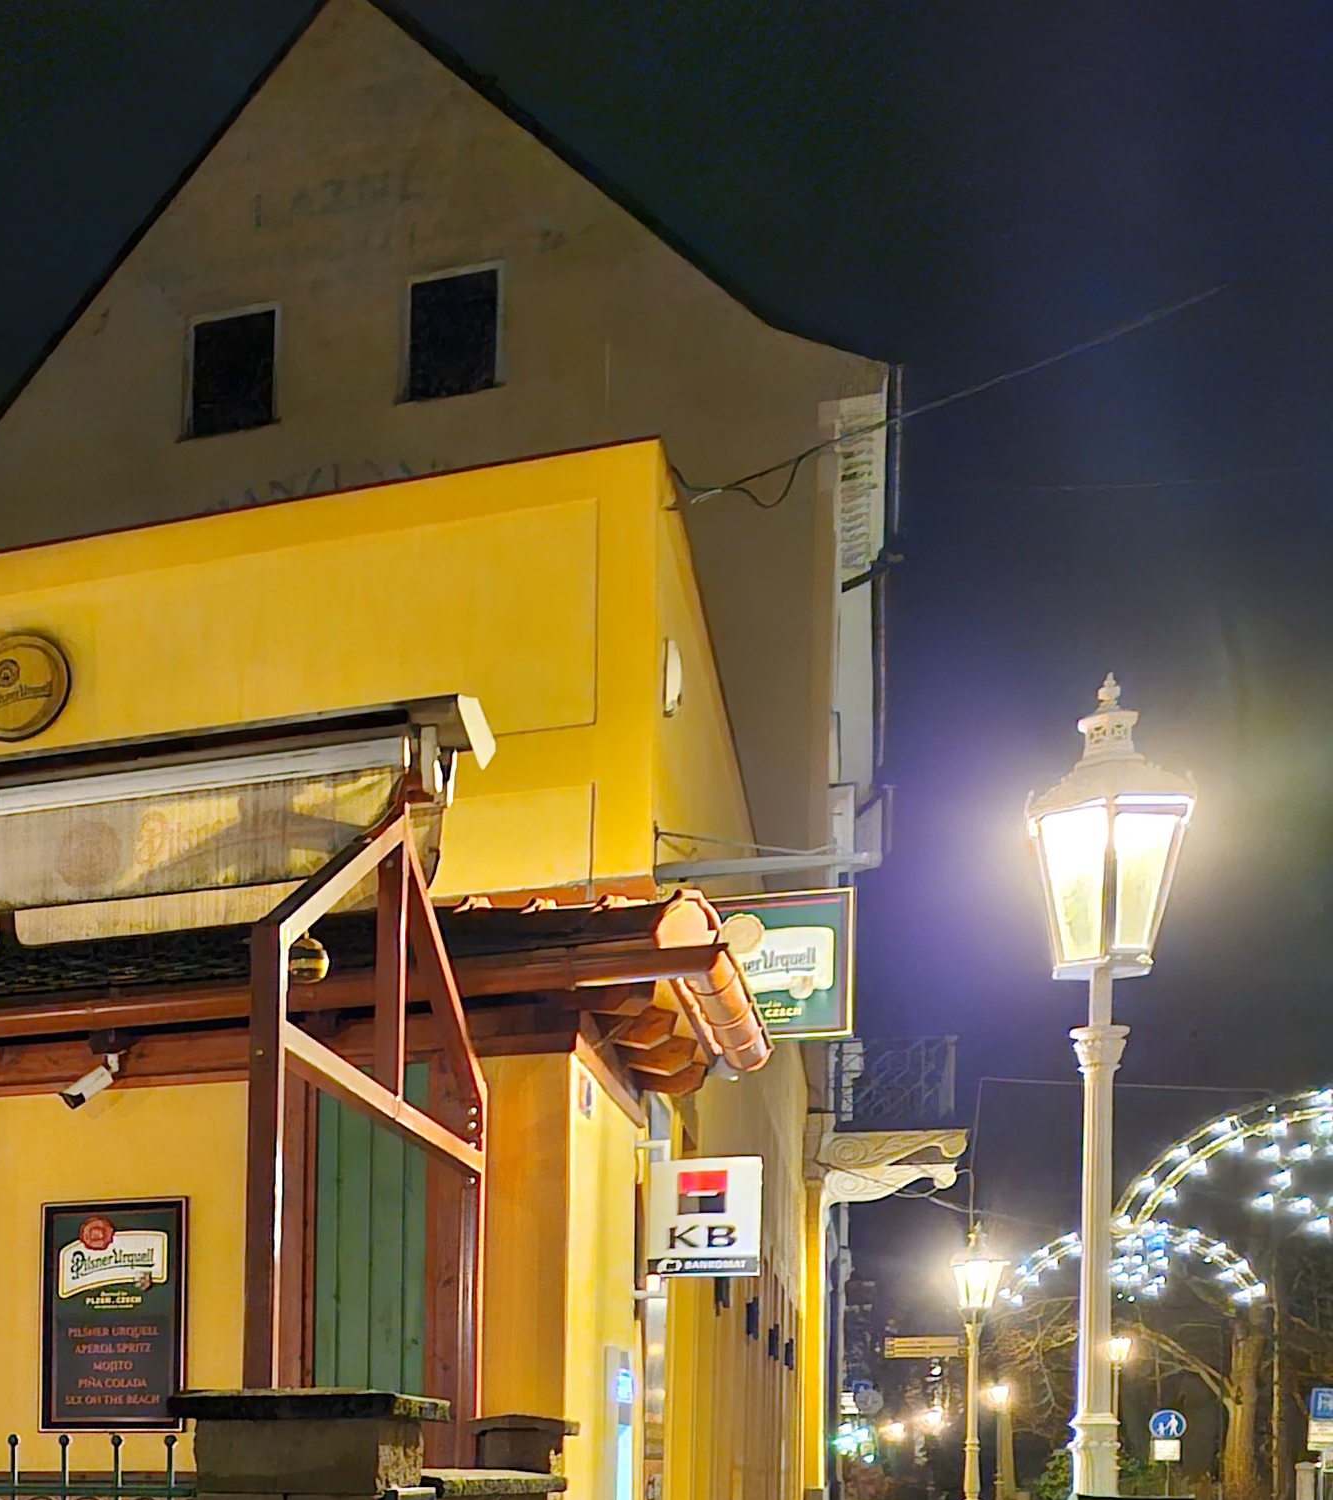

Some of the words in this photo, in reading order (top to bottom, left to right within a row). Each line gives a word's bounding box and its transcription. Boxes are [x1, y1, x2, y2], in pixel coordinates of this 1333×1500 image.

[761, 947, 816, 974] Urquell
[667, 1225, 738, 1250] KB
[70, 1250, 117, 1280] Pilsner
[114, 1248, 155, 1270] Urquell
[68, 1327, 110, 1338] PILSNER
[112, 1326, 159, 1339] URQUELL
[75, 1344, 114, 1354] APEROL
[116, 1343, 152, 1353] SPRITZ
[93, 1360, 133, 1372] MOJITO
[78, 1375, 103, 1388] PIÑA
[105, 1377, 147, 1387] COLADA
[65, 1395, 83, 1405] SEX
[85, 1395, 102, 1405] ON
[104, 1394, 124, 1405] THE
[126, 1394, 160, 1404] BEACH
